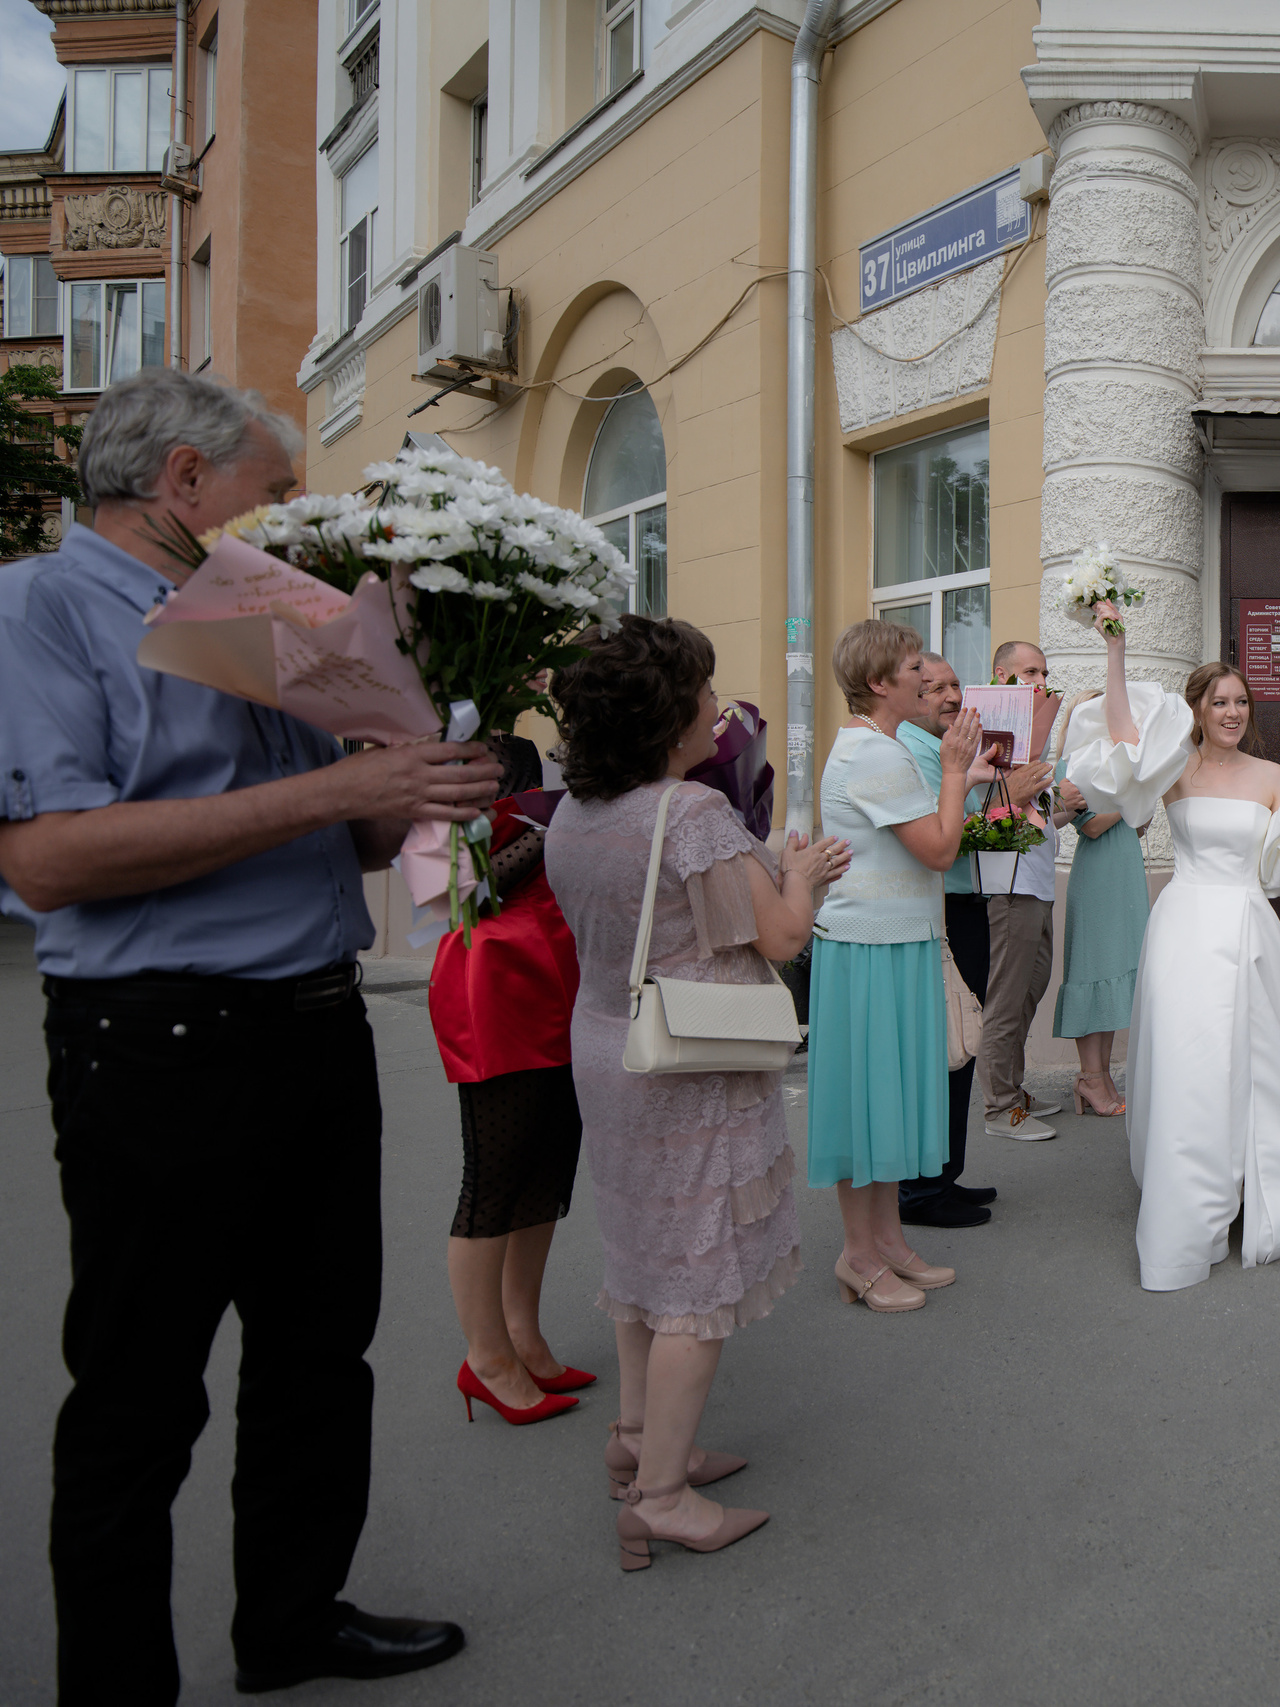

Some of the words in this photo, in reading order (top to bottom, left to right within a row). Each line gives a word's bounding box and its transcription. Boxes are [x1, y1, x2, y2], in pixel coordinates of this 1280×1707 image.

[895, 233, 926, 261] улица
[896, 228, 986, 285] Цвиллинга
[864, 251, 891, 297] 37
